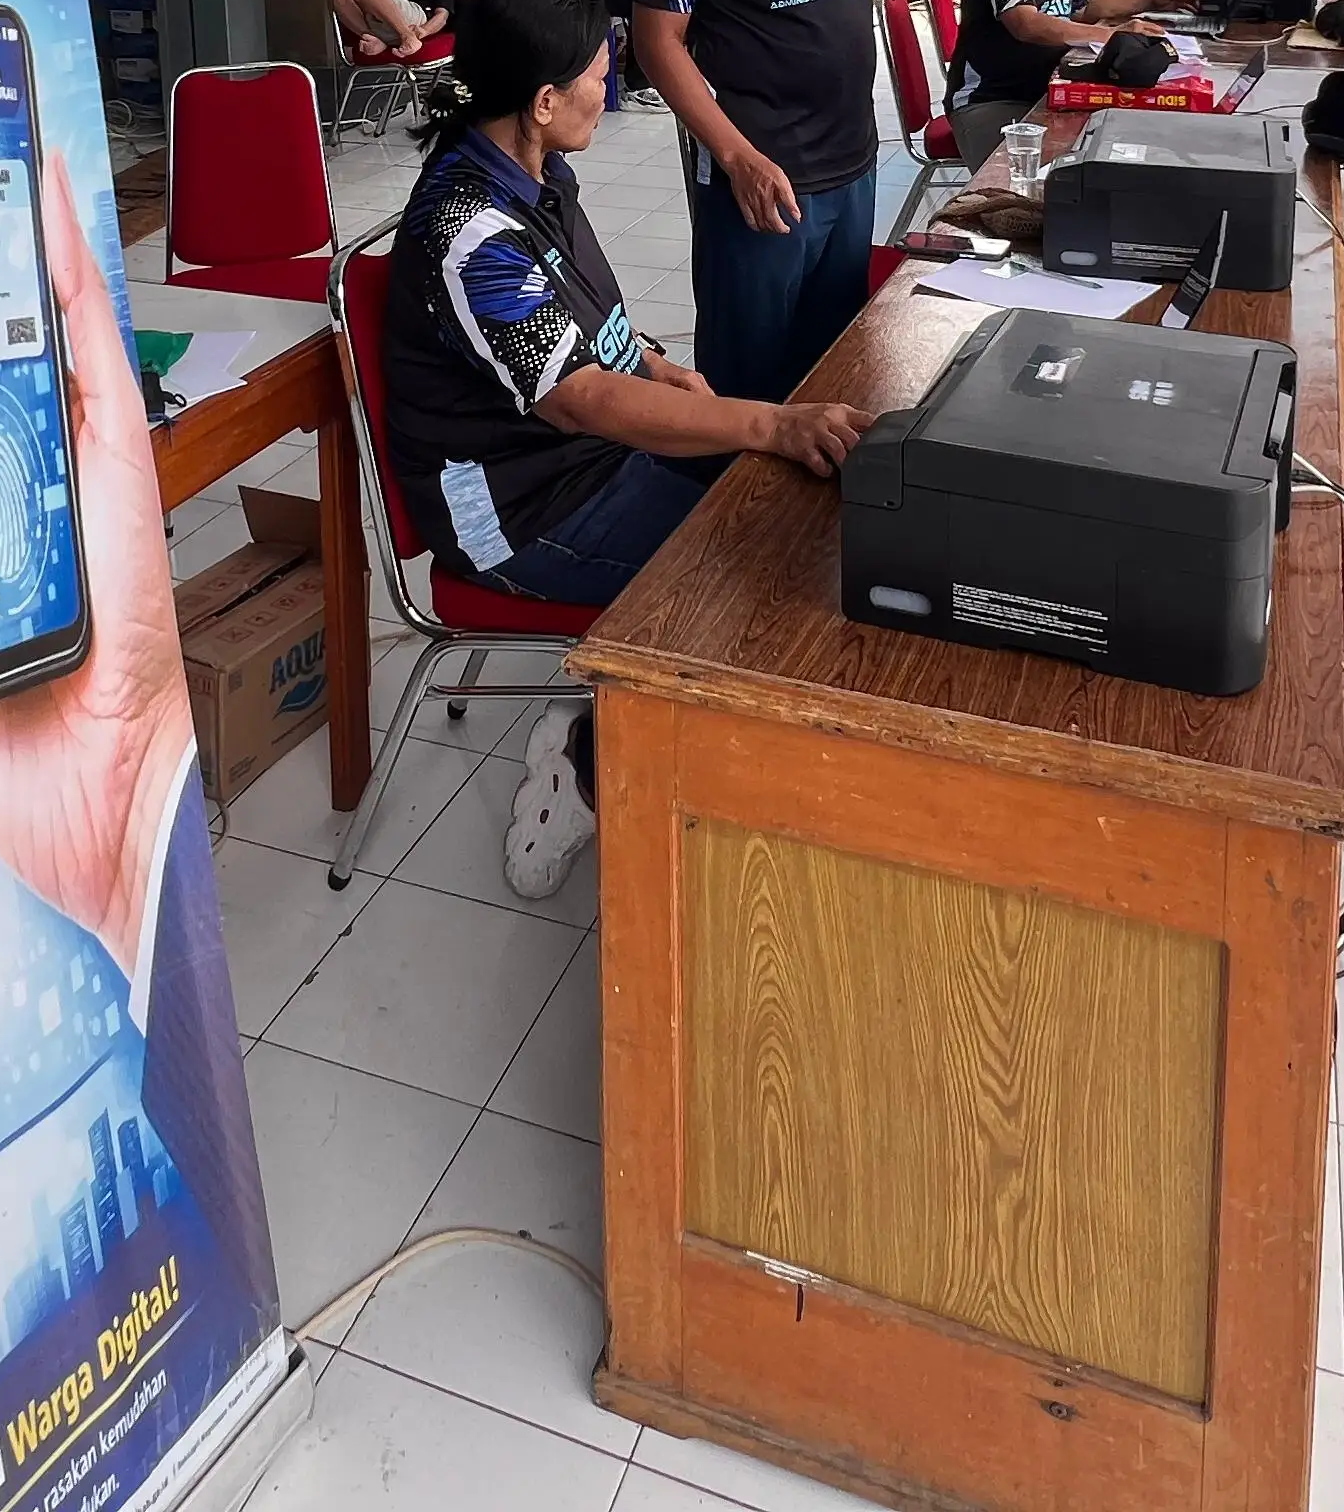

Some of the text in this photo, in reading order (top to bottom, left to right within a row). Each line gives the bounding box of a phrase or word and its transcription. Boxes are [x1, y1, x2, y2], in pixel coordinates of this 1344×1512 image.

[6, 1360, 95, 1467] Warga
[97, 1254, 181, 1382] Digital!
[44, 1444, 98, 1512] rasakan
[98, 1368, 169, 1456] kemudahan
